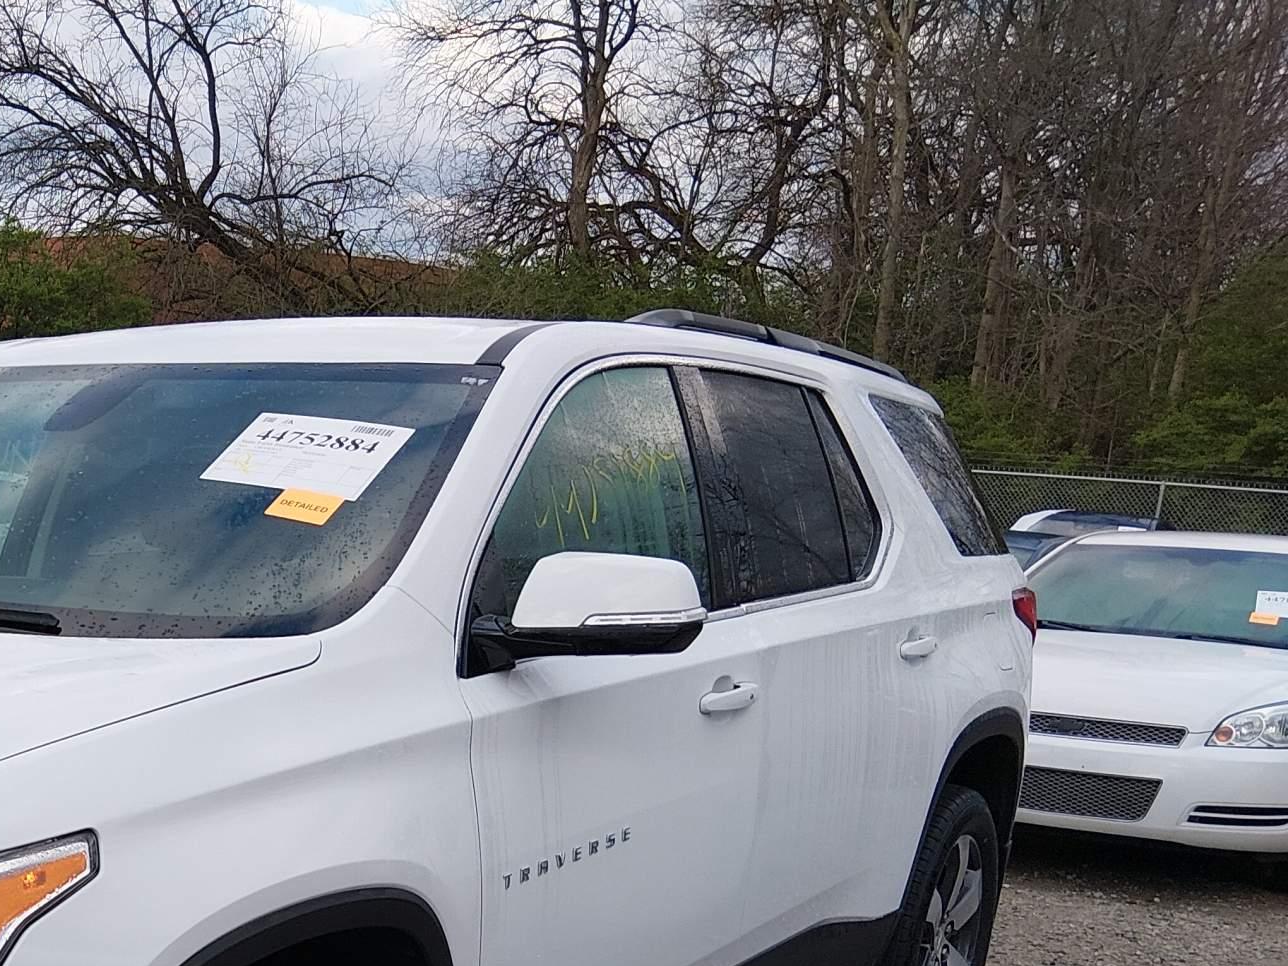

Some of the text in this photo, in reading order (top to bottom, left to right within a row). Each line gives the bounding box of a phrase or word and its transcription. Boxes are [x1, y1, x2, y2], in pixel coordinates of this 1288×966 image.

[255, 428, 381, 455] 44752884
[279, 498, 329, 514] DETAILED
[503, 827, 631, 890] TRAVERSE
